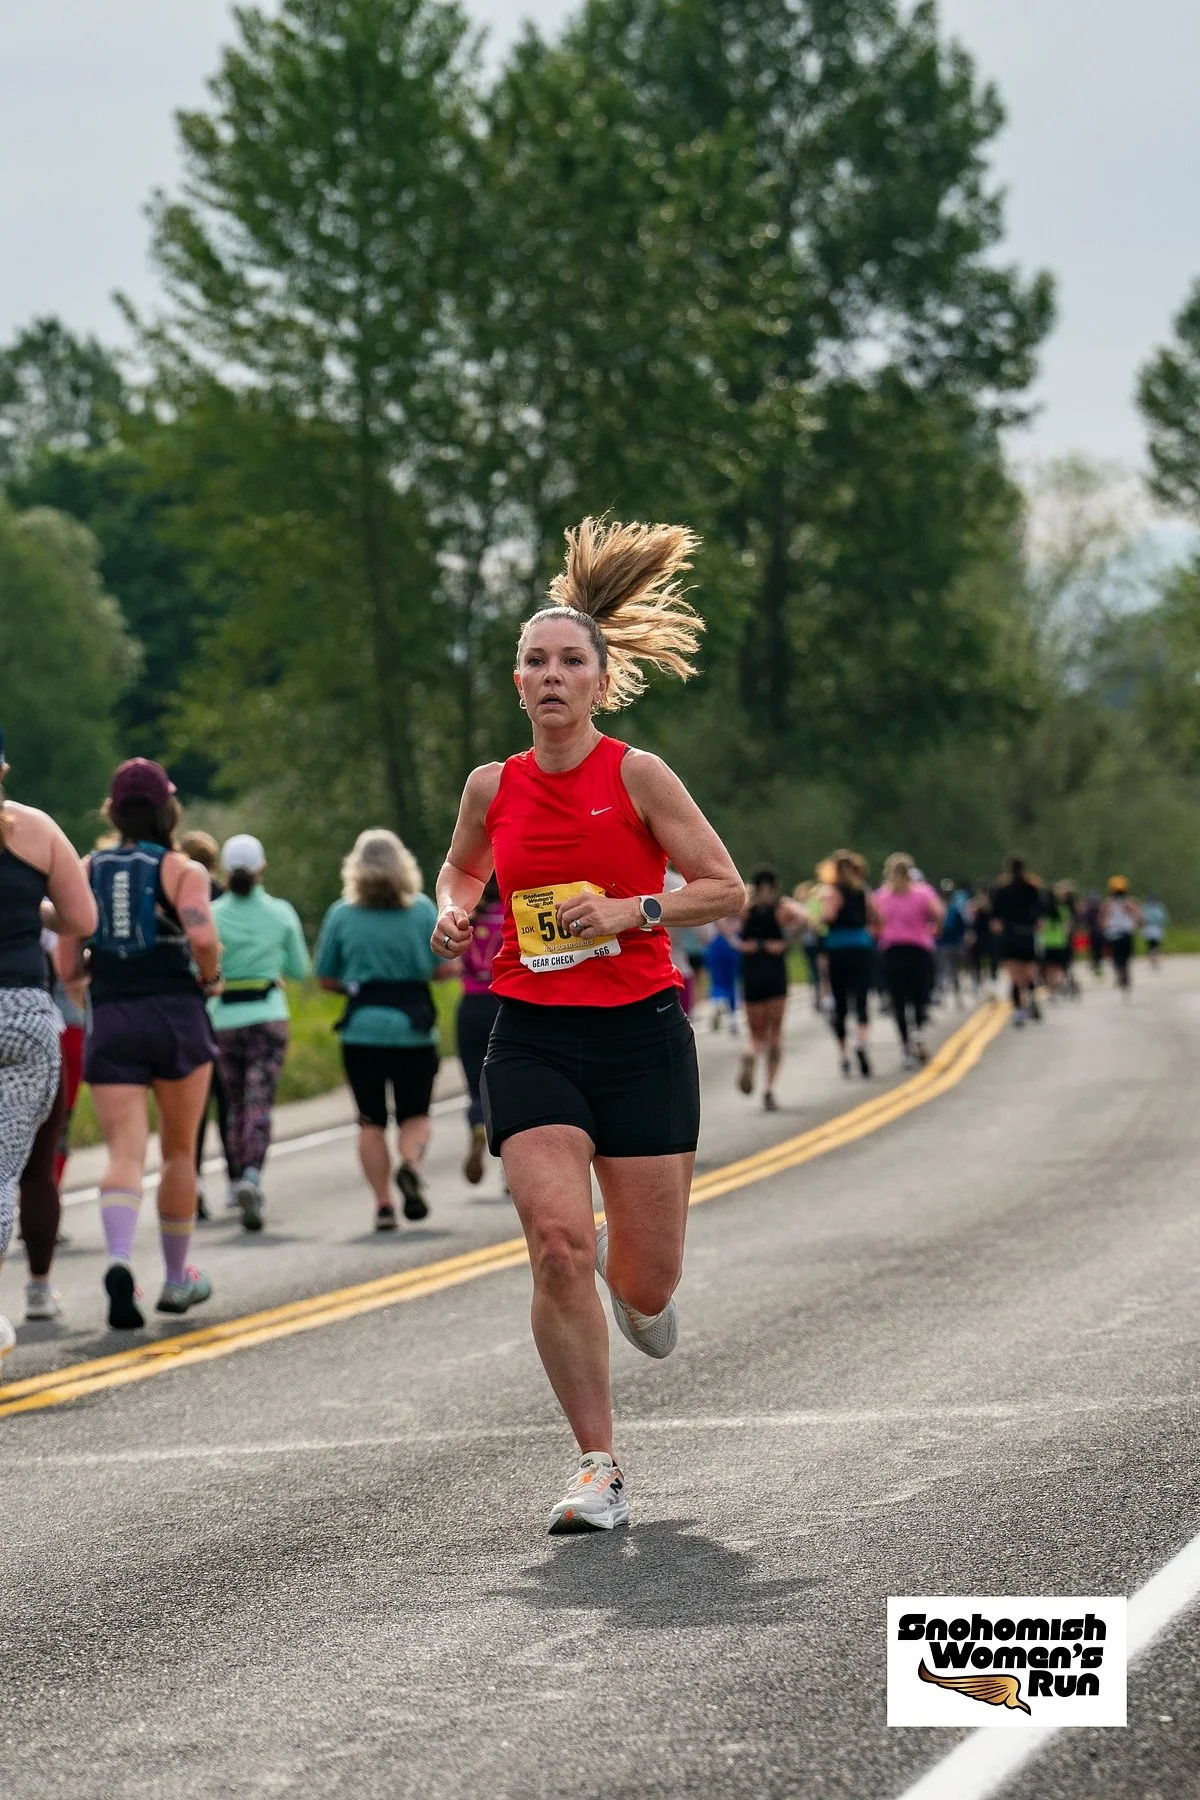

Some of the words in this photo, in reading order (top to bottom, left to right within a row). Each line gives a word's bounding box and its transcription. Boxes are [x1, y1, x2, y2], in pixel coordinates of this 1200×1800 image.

[521, 926, 535, 934] 10K
[555, 943, 573, 951] SUPER
[573, 940, 593, 949] SERIES
[594, 945, 610, 957] 566
[532, 958, 549, 968] GEAR
[551, 954, 575, 966] CHECK
